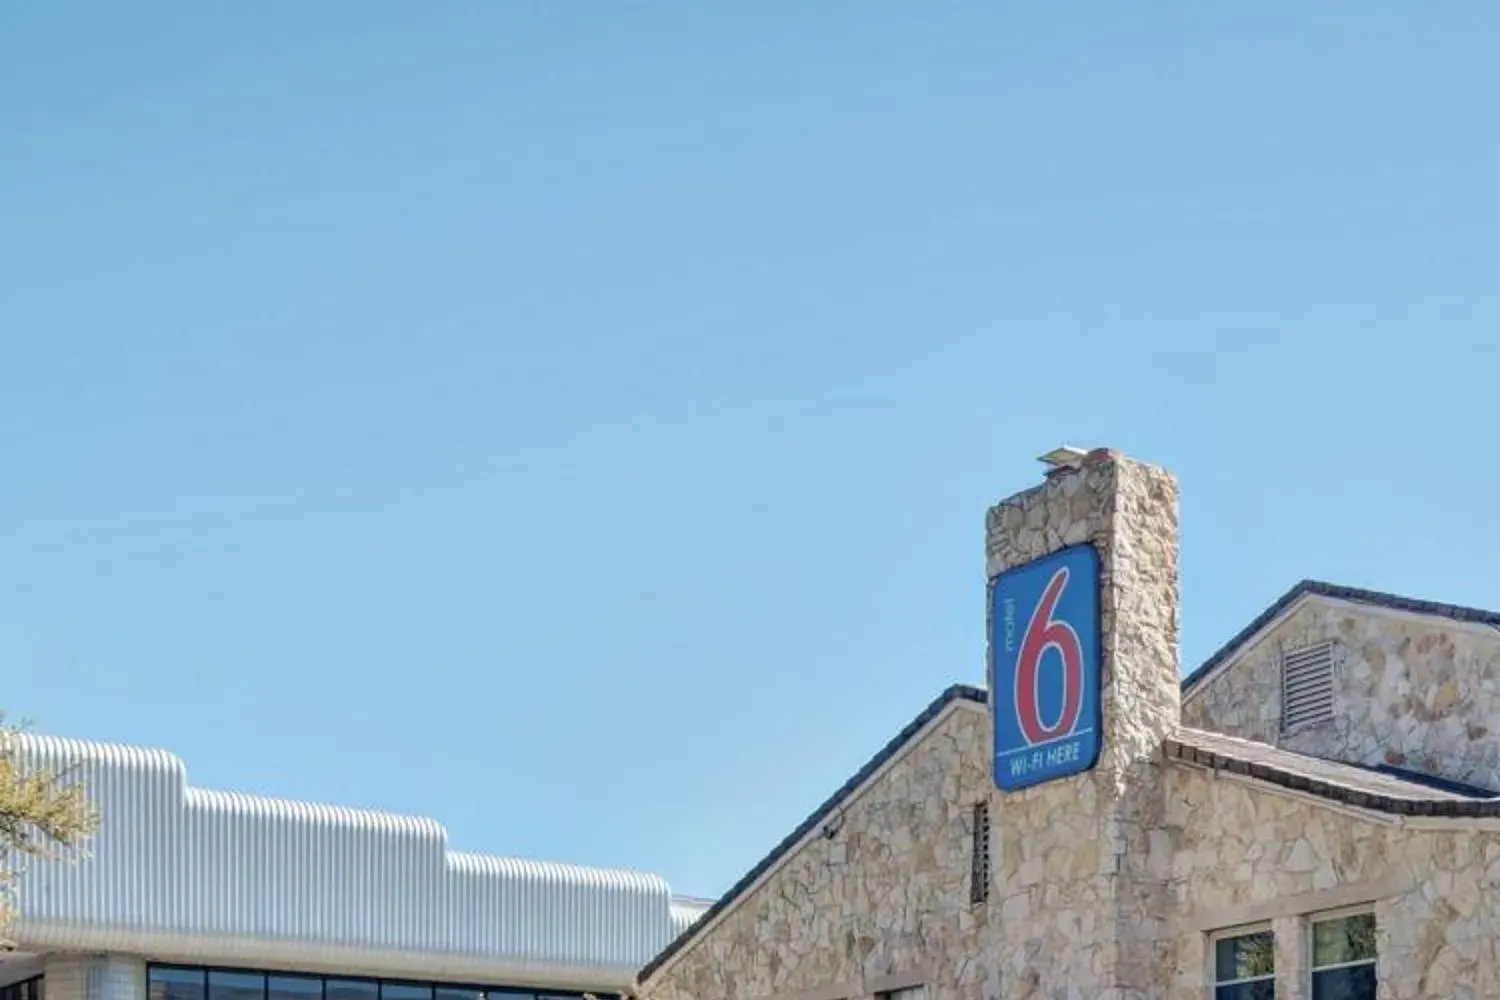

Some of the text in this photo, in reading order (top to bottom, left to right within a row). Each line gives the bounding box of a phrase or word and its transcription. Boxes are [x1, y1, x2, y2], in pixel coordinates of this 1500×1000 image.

[1013, 565, 1084, 747] 6
[1011, 741, 1080, 776] WI-FI HERE
